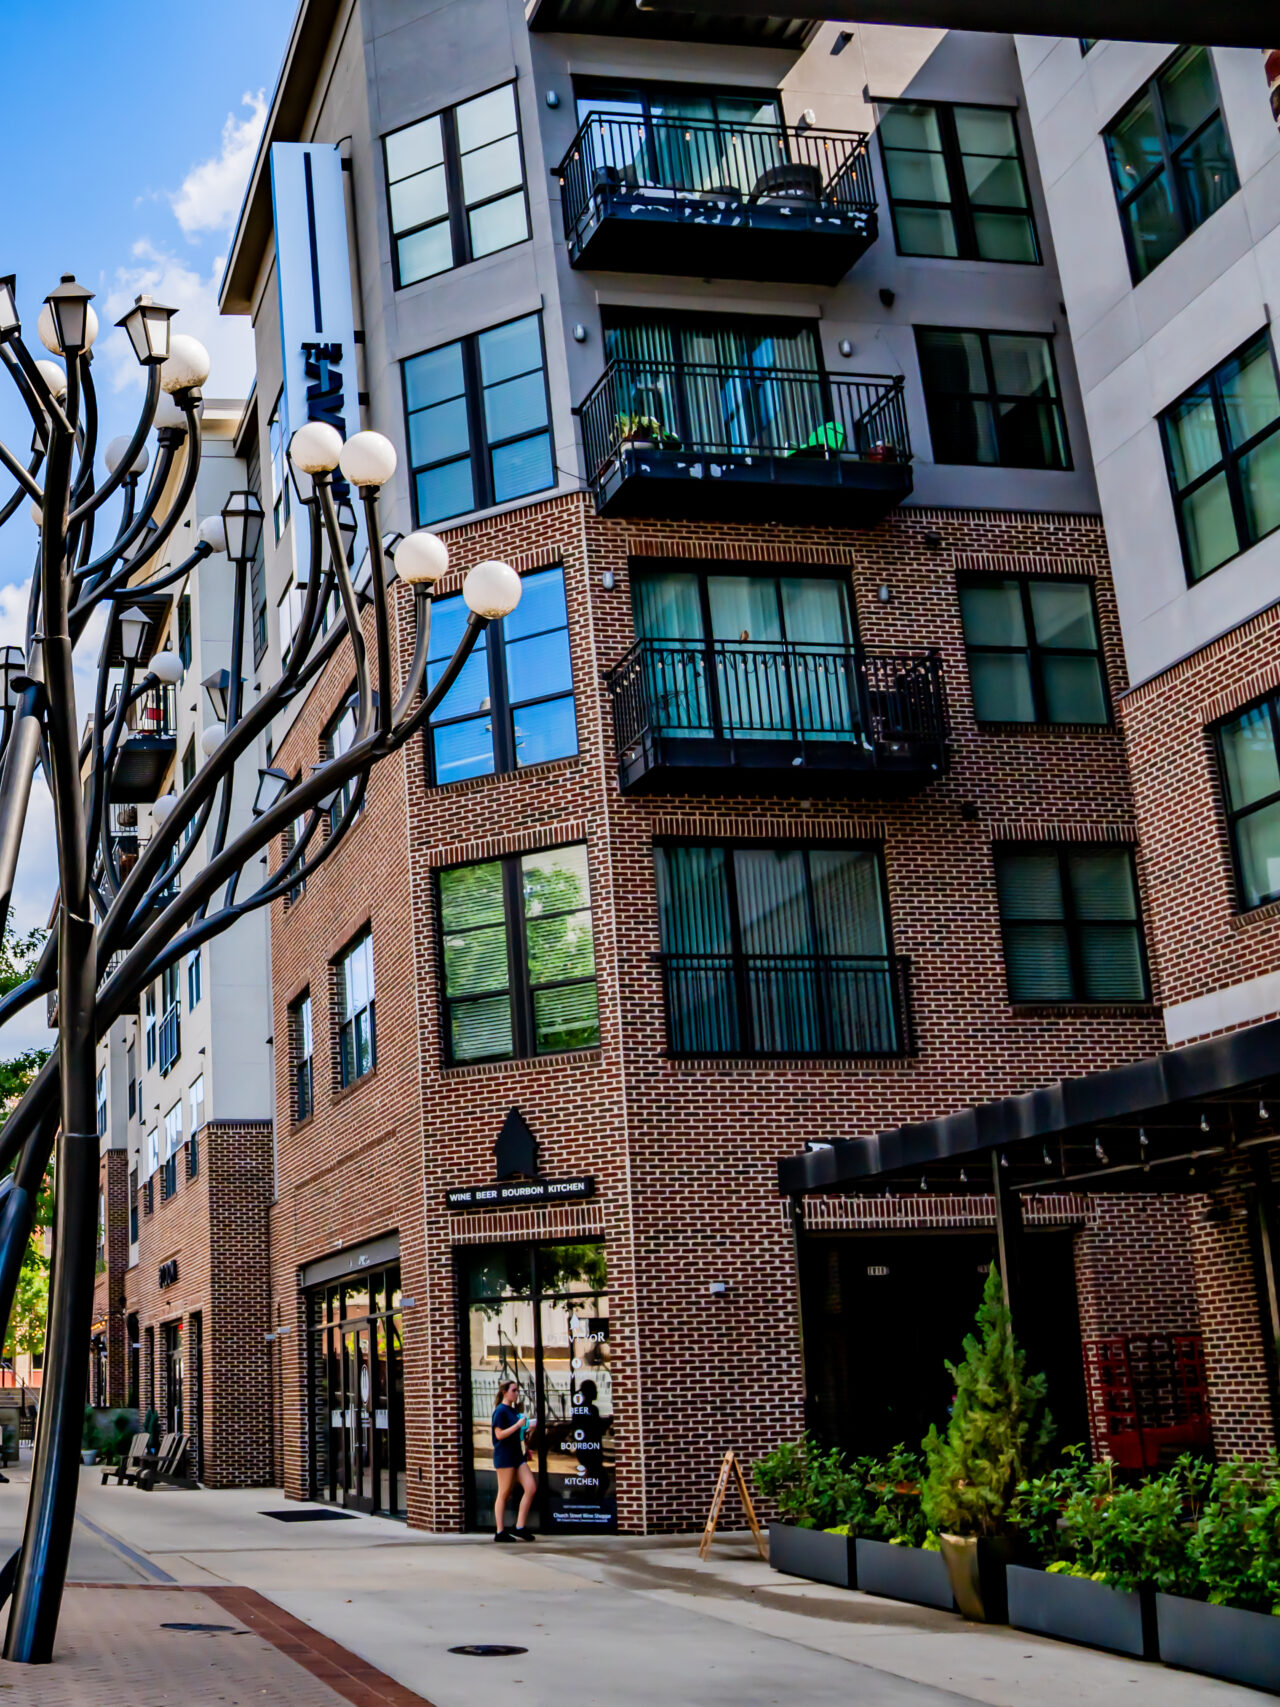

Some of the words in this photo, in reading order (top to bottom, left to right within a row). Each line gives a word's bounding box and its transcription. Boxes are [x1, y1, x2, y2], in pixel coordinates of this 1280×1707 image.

[450, 1192, 471, 1201] WINE
[476, 1190, 497, 1199] BEER
[502, 1186, 544, 1197] BOURBON
[548, 1182, 585, 1193] KITCHEN
[570, 1406, 589, 1415] BEER
[560, 1442, 600, 1450] BOURBON
[564, 1478, 599, 1486] KITCHEN
